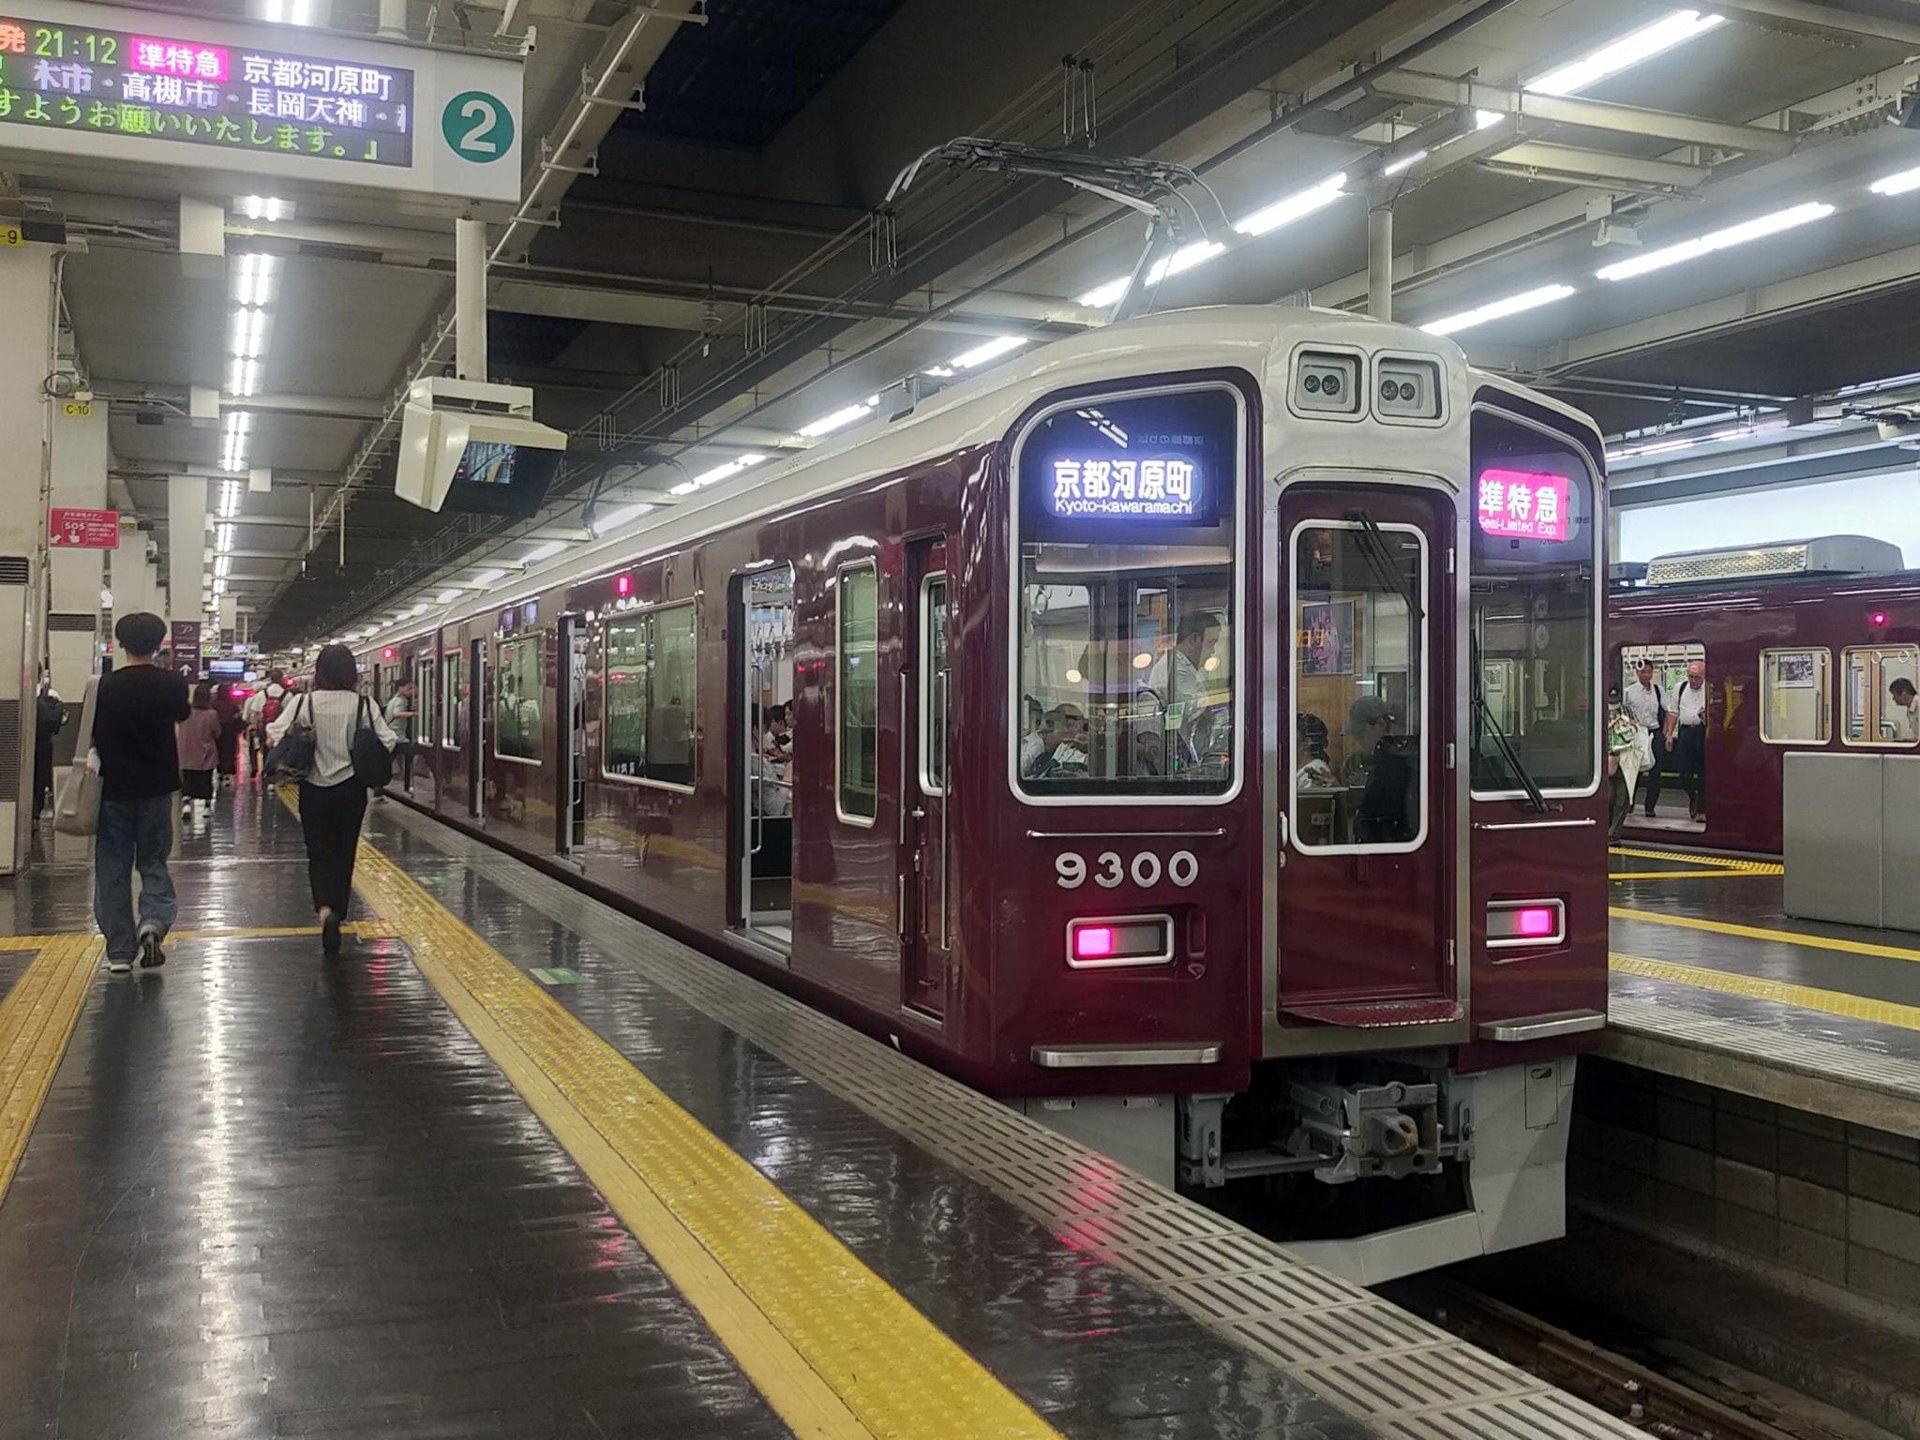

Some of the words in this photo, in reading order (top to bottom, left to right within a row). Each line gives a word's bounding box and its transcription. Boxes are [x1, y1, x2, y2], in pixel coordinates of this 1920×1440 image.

[35, 28, 117, 64] 21:12
[138, 42, 221, 78] 準特急
[242, 55, 392, 101] 京都河原町
[460, 99, 497, 153] 2
[66, 404, 89, 416] C-10
[1053, 459, 1194, 500] 京都河原町
[1479, 479, 1558, 523] 準特急
[64, 522, 86, 531] SOS
[1055, 850, 1199, 889] 9300
